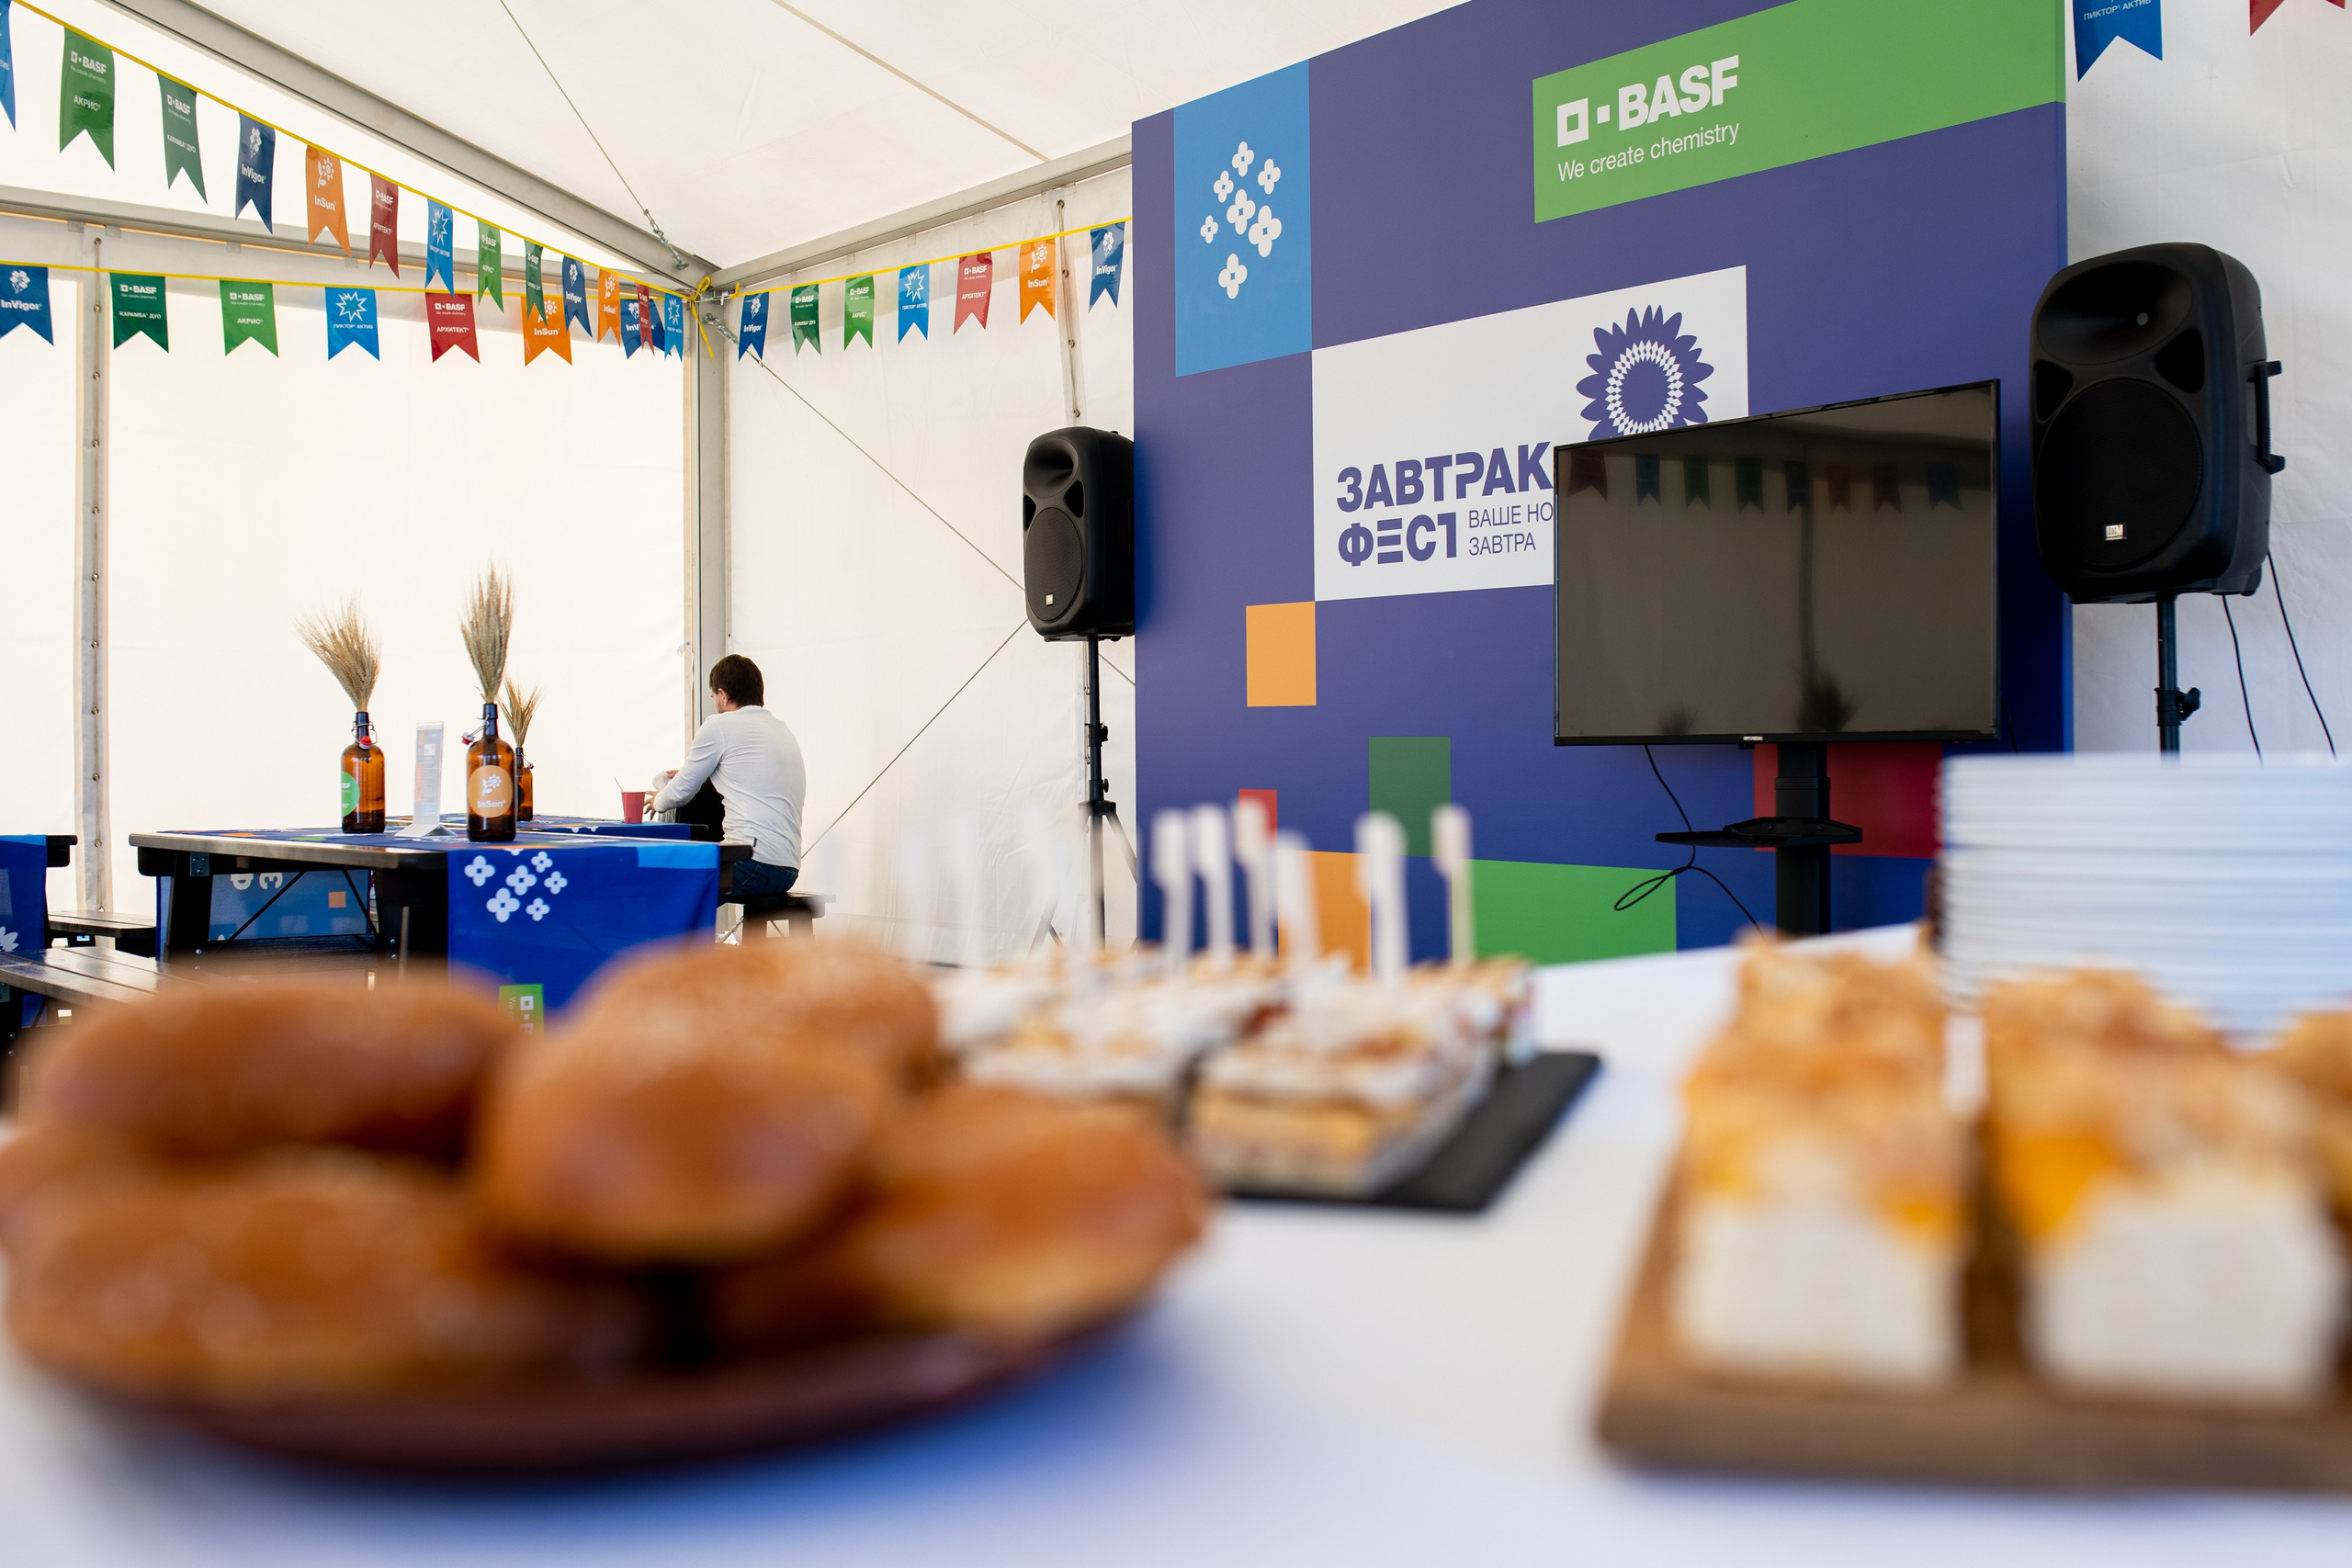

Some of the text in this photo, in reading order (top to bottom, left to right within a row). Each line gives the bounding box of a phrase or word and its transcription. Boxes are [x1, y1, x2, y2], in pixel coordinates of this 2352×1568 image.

[83, 56, 107, 73] BASF
[1619, 54, 1738, 131] BASF
[175, 98, 190, 115] BASF
[1557, 123, 1739, 182] We create chemistry
[972, 265, 987, 274] BASF
[133, 285, 157, 294] BASF
[242, 293, 265, 301] BASF
[802, 295, 814, 303] BASF
[1337, 441, 1554, 513] ЗАВТРАК
[1469, 505, 1521, 528] ВАШЕ
[1339, 513, 1457, 567] ФЕСТ
[1469, 533, 1536, 556] ЗАВТРА
